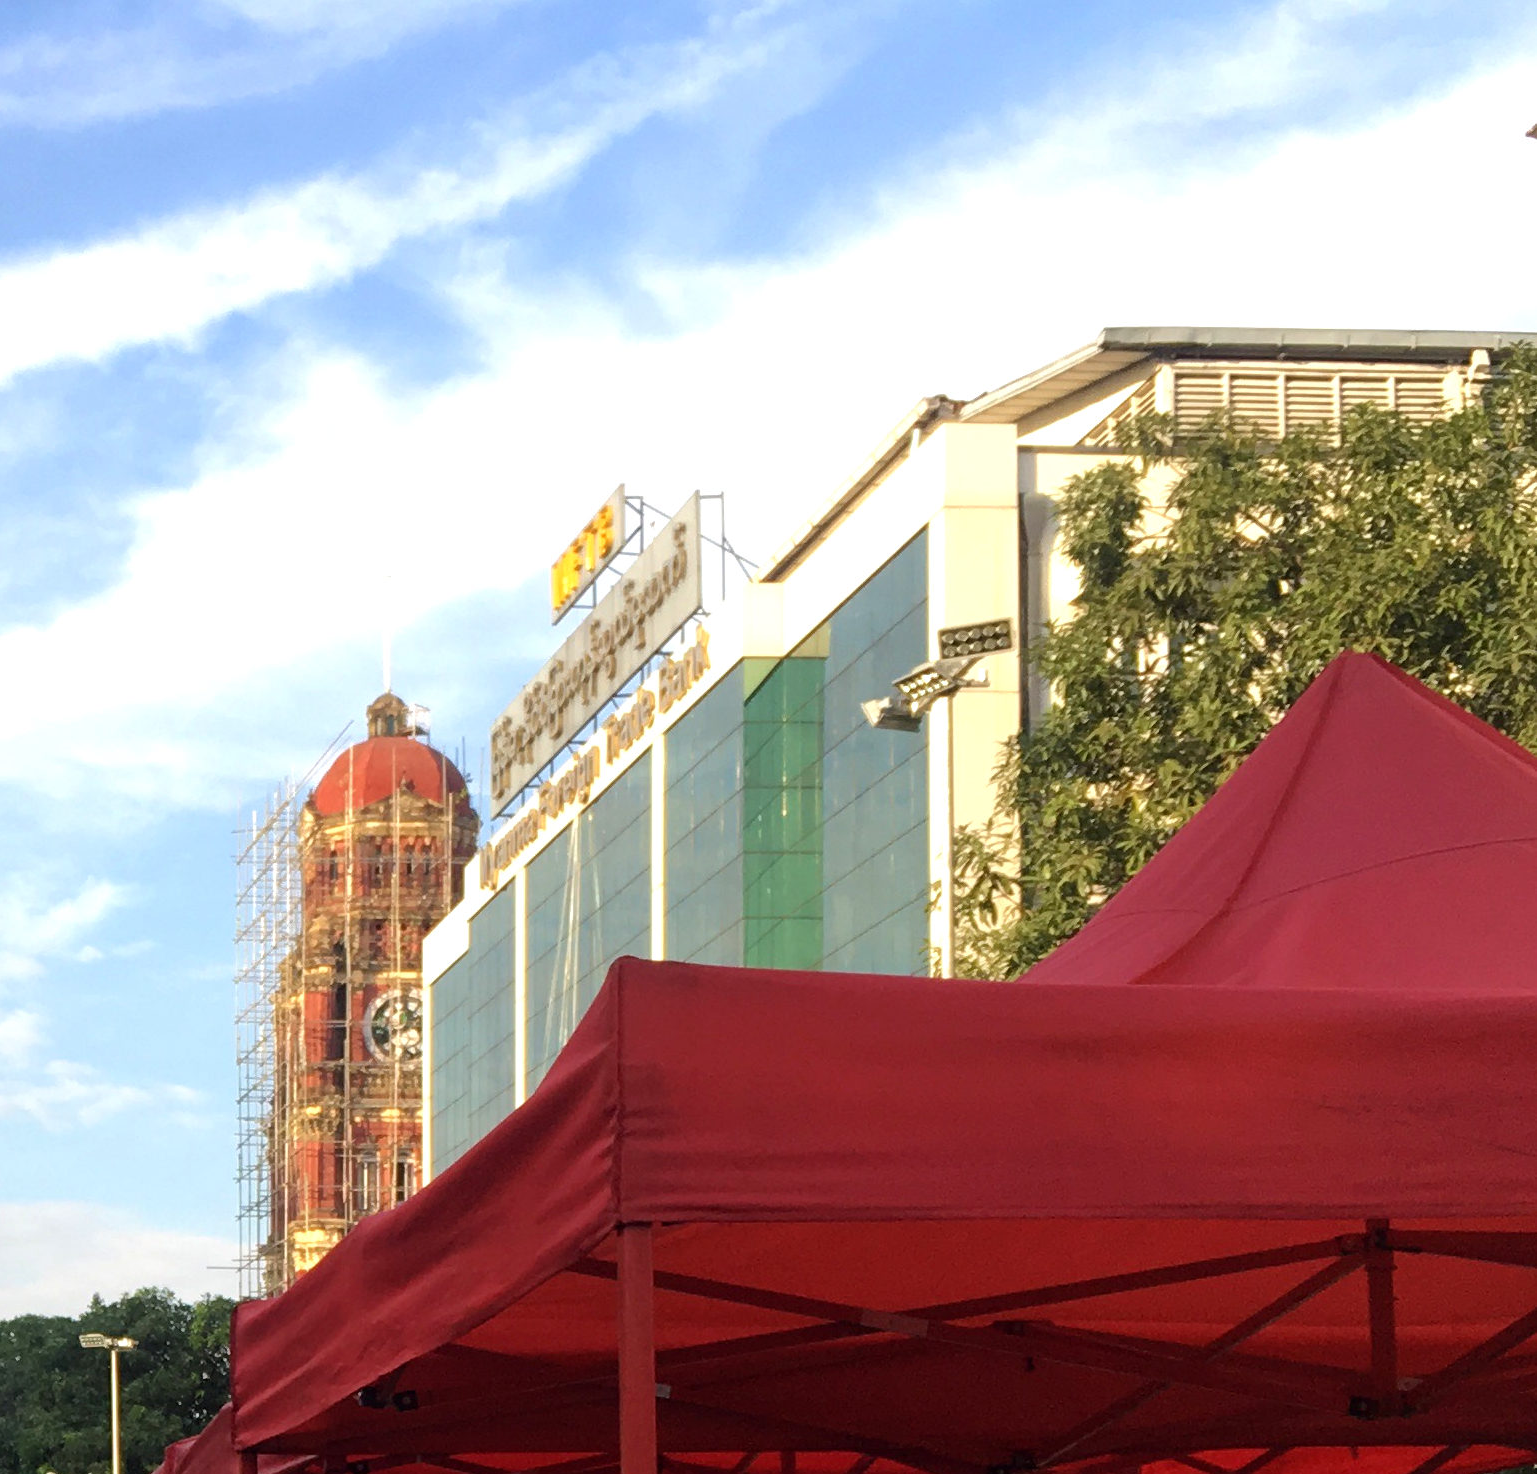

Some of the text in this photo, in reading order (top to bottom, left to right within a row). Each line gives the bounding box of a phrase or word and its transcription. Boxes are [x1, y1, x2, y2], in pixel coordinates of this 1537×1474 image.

[538, 745, 601, 830] Foreign
[603, 685, 656, 765] Trade
[658, 622, 712, 715] Bank
